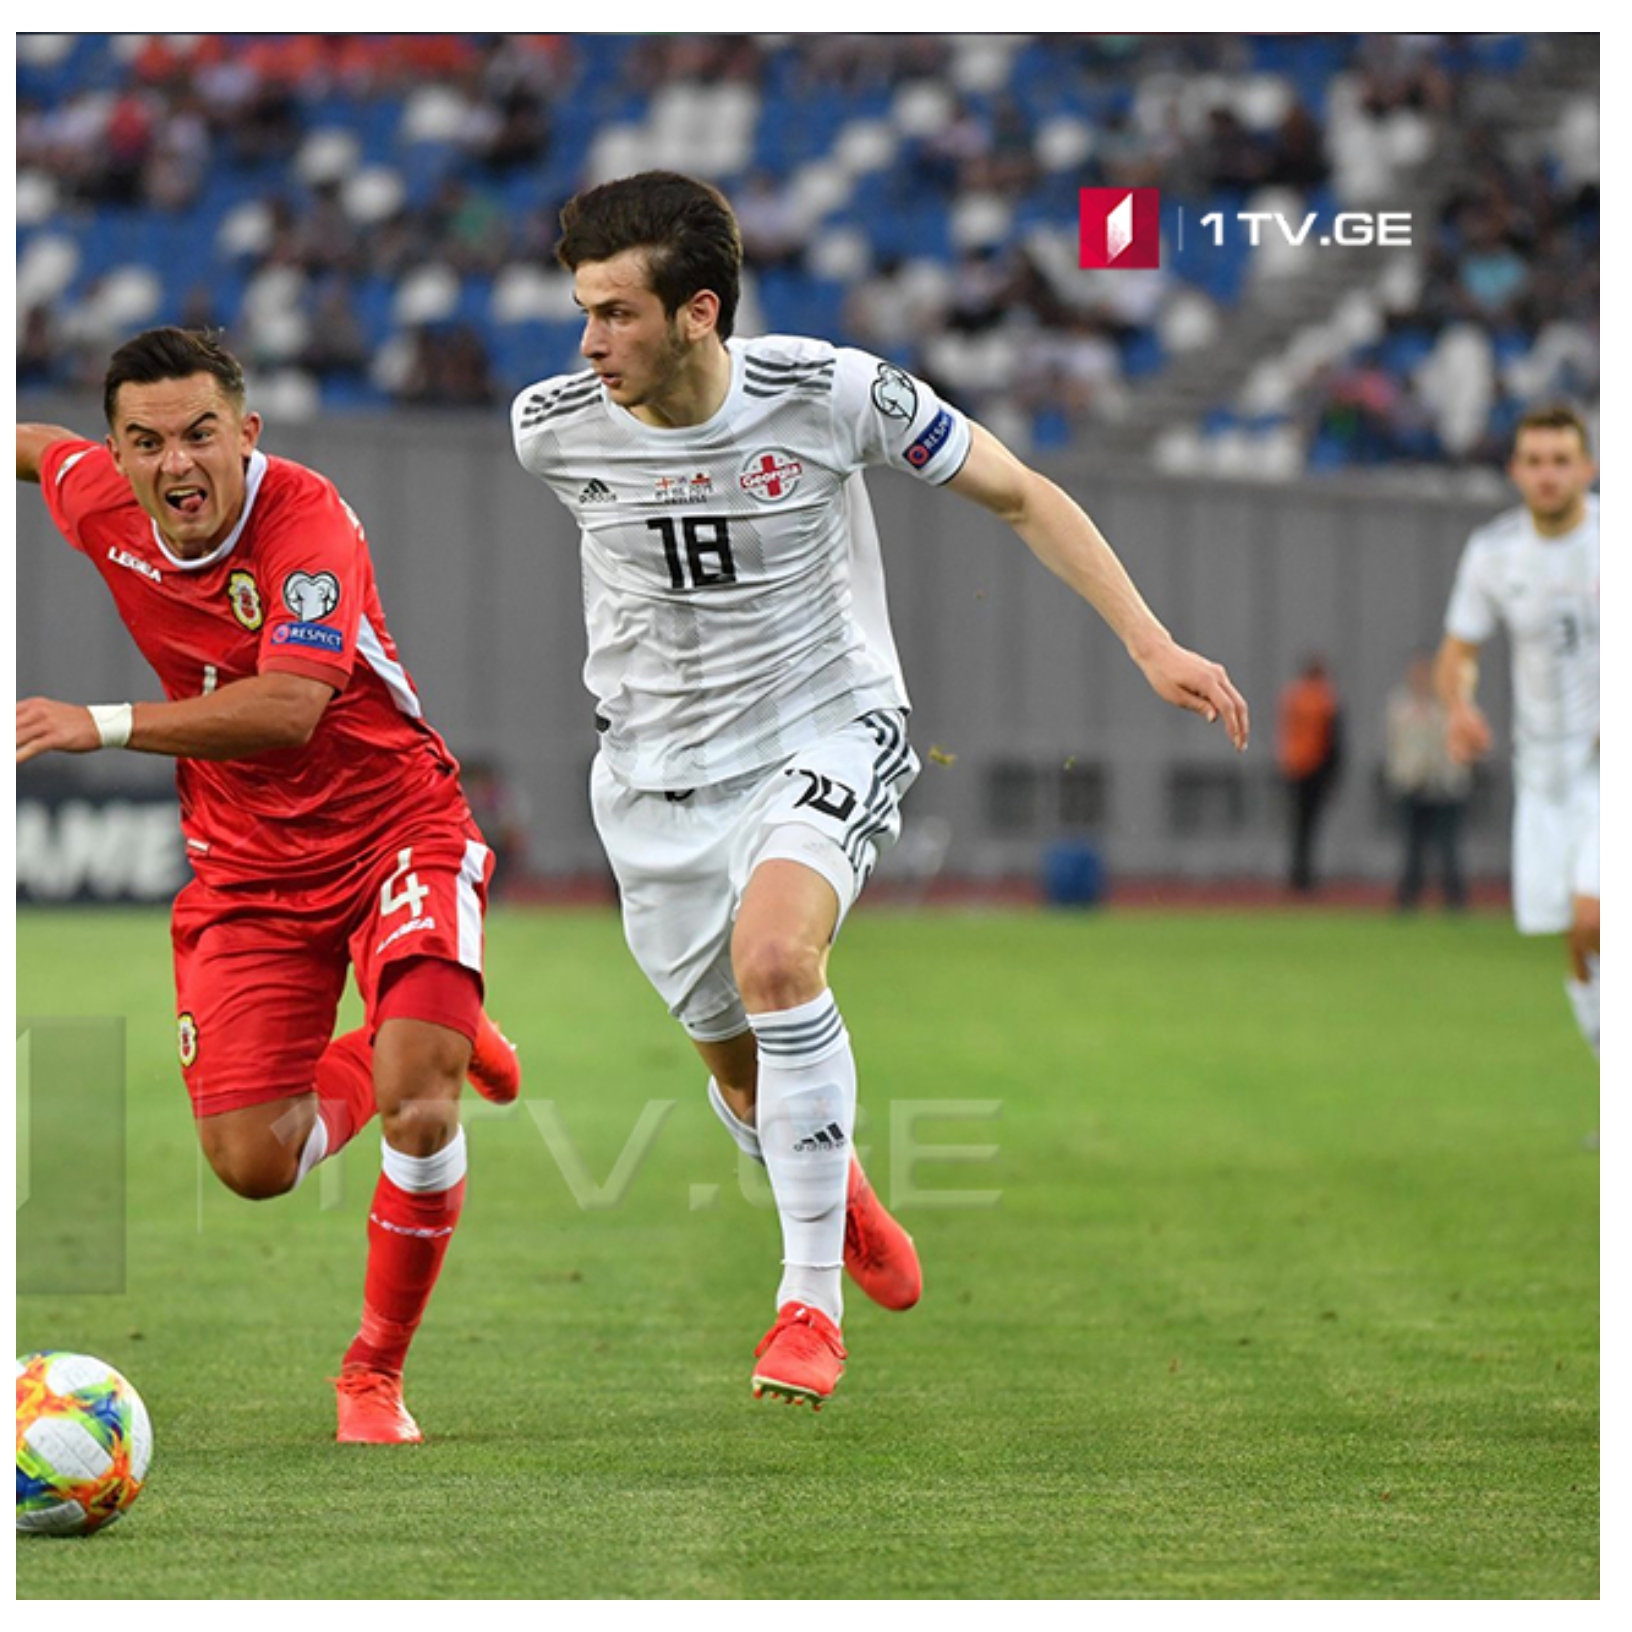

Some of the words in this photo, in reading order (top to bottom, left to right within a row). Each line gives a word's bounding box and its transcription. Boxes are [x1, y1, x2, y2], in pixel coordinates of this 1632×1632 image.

[645, 516, 737, 589] 18
[289, 628, 343, 647] RESPECT
[380, 846, 430, 918] 4
